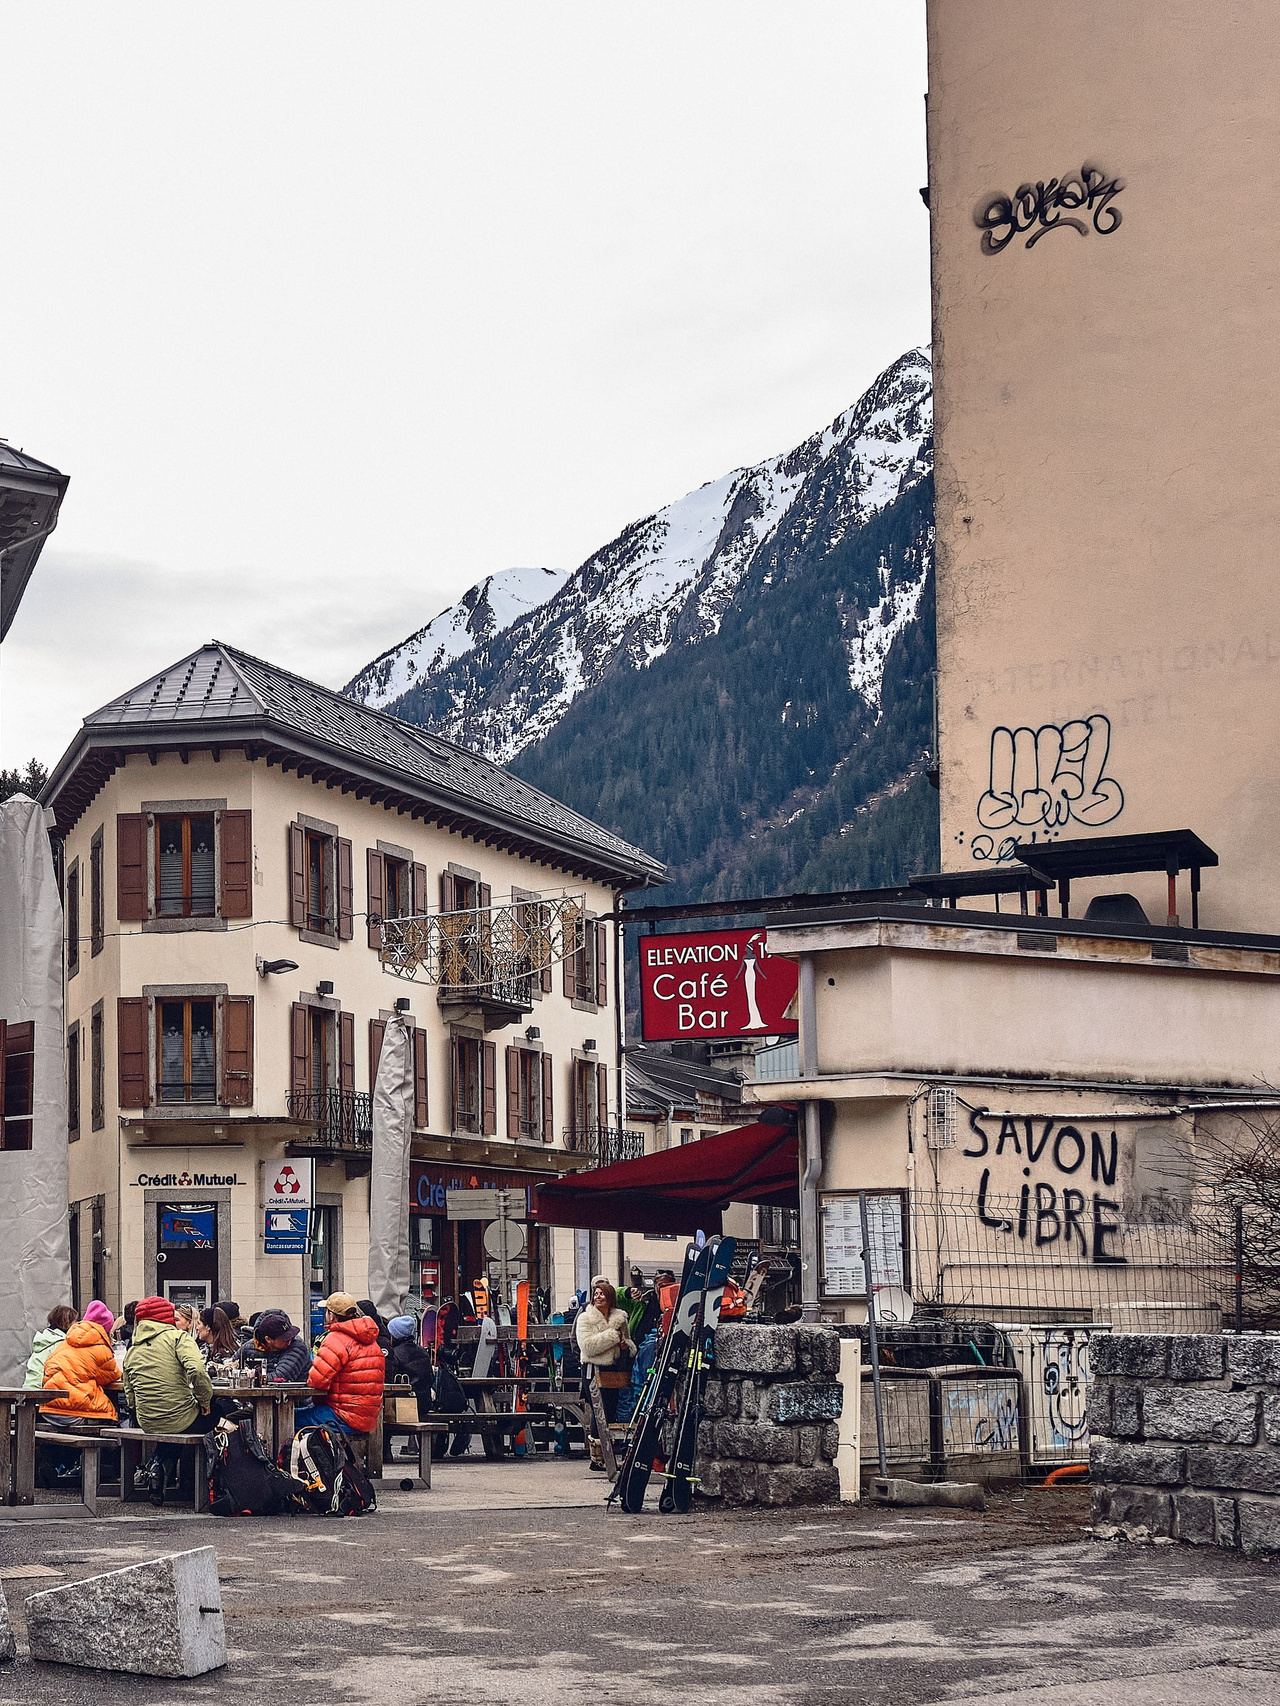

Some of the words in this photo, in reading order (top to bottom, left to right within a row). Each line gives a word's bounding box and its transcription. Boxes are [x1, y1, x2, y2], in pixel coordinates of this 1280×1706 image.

[647, 943, 738, 966] ELEVATION
[653, 973, 728, 1001] Café
[678, 1003, 729, 1030] Bar
[963, 1106, 1118, 1186] SAVON
[137, 1174, 178, 1186] Crédit
[193, 1173, 238, 1186] Mutuel
[417, 1174, 463, 1208] Cré
